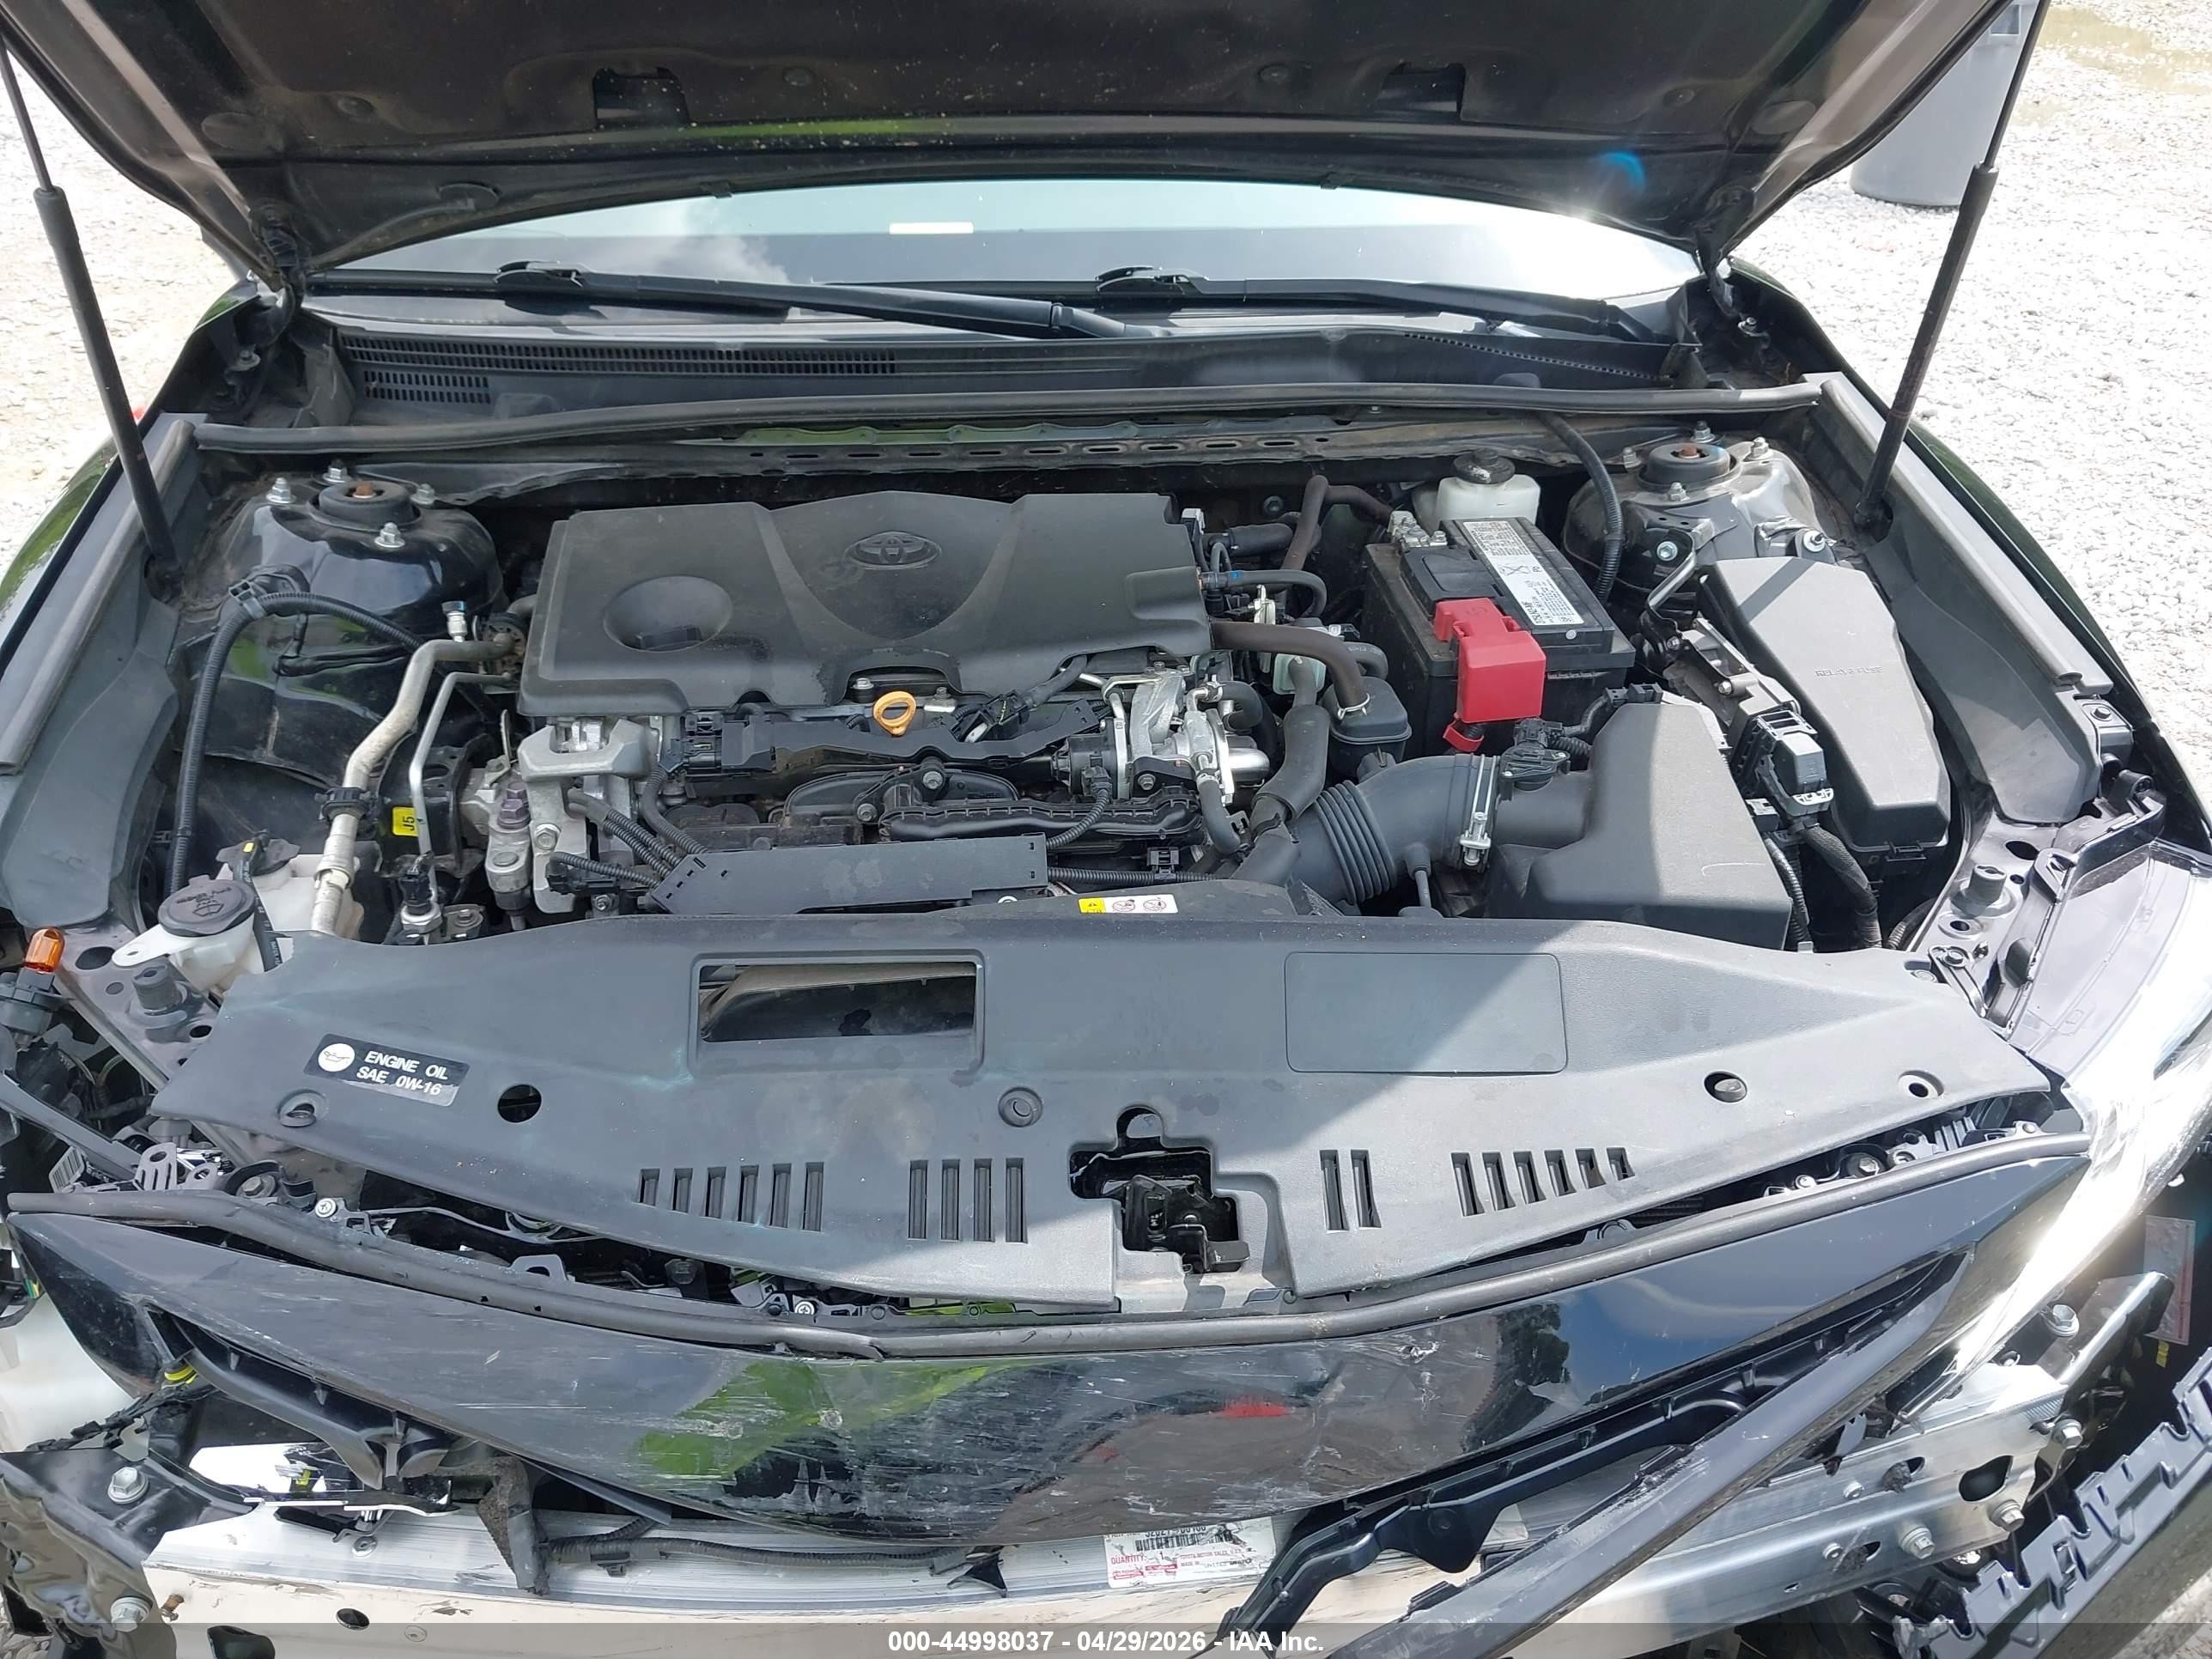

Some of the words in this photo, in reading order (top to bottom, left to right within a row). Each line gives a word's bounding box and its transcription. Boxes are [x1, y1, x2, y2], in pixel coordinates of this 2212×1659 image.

[1814, 668, 1847, 678] RELAY
[1856, 665, 1883, 674] FUSE
[402, 816, 416, 831] J5
[364, 1050, 420, 1073] ENGINE
[425, 1064, 449, 1080] OIL
[356, 1066, 390, 1084] SAE
[395, 1075, 442, 1096] 0W-16
[1111, 1553, 1147, 1565] QUANTITY:
